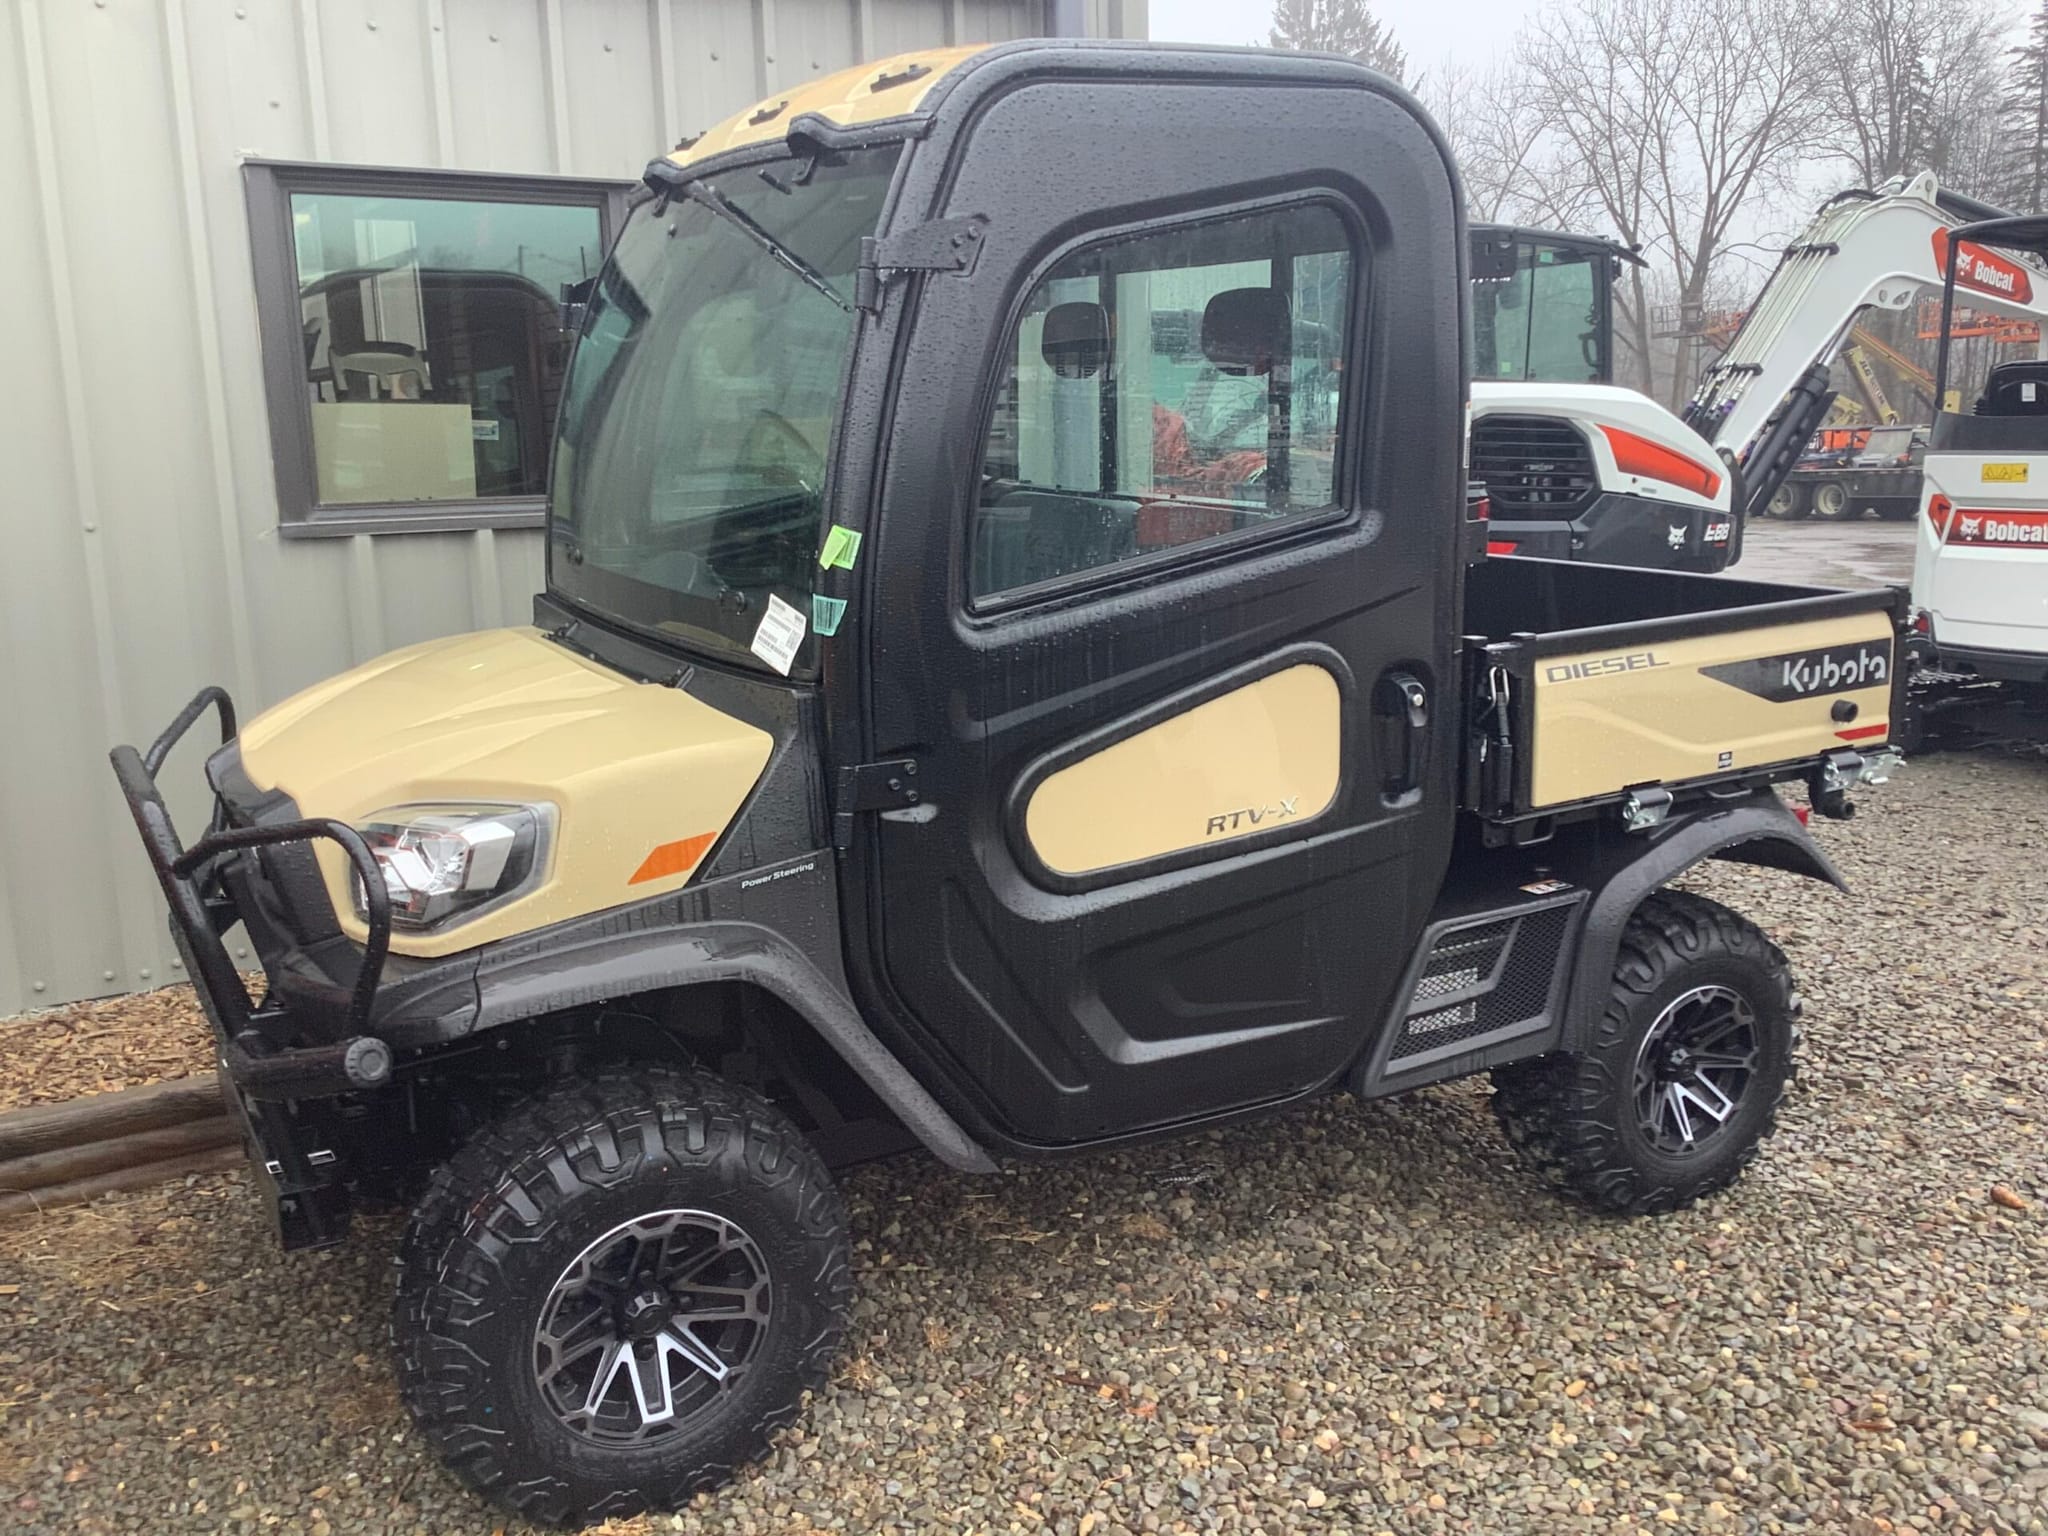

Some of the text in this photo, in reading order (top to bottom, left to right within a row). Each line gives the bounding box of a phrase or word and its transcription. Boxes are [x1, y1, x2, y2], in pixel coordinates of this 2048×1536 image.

[1974, 260, 2015, 292] Bobcat
[1546, 652, 1670, 683] DIESEL
[1783, 648, 1886, 692] Kubota
[1206, 796, 1299, 835] RTV-X
[741, 862, 815, 889] Power Steering
